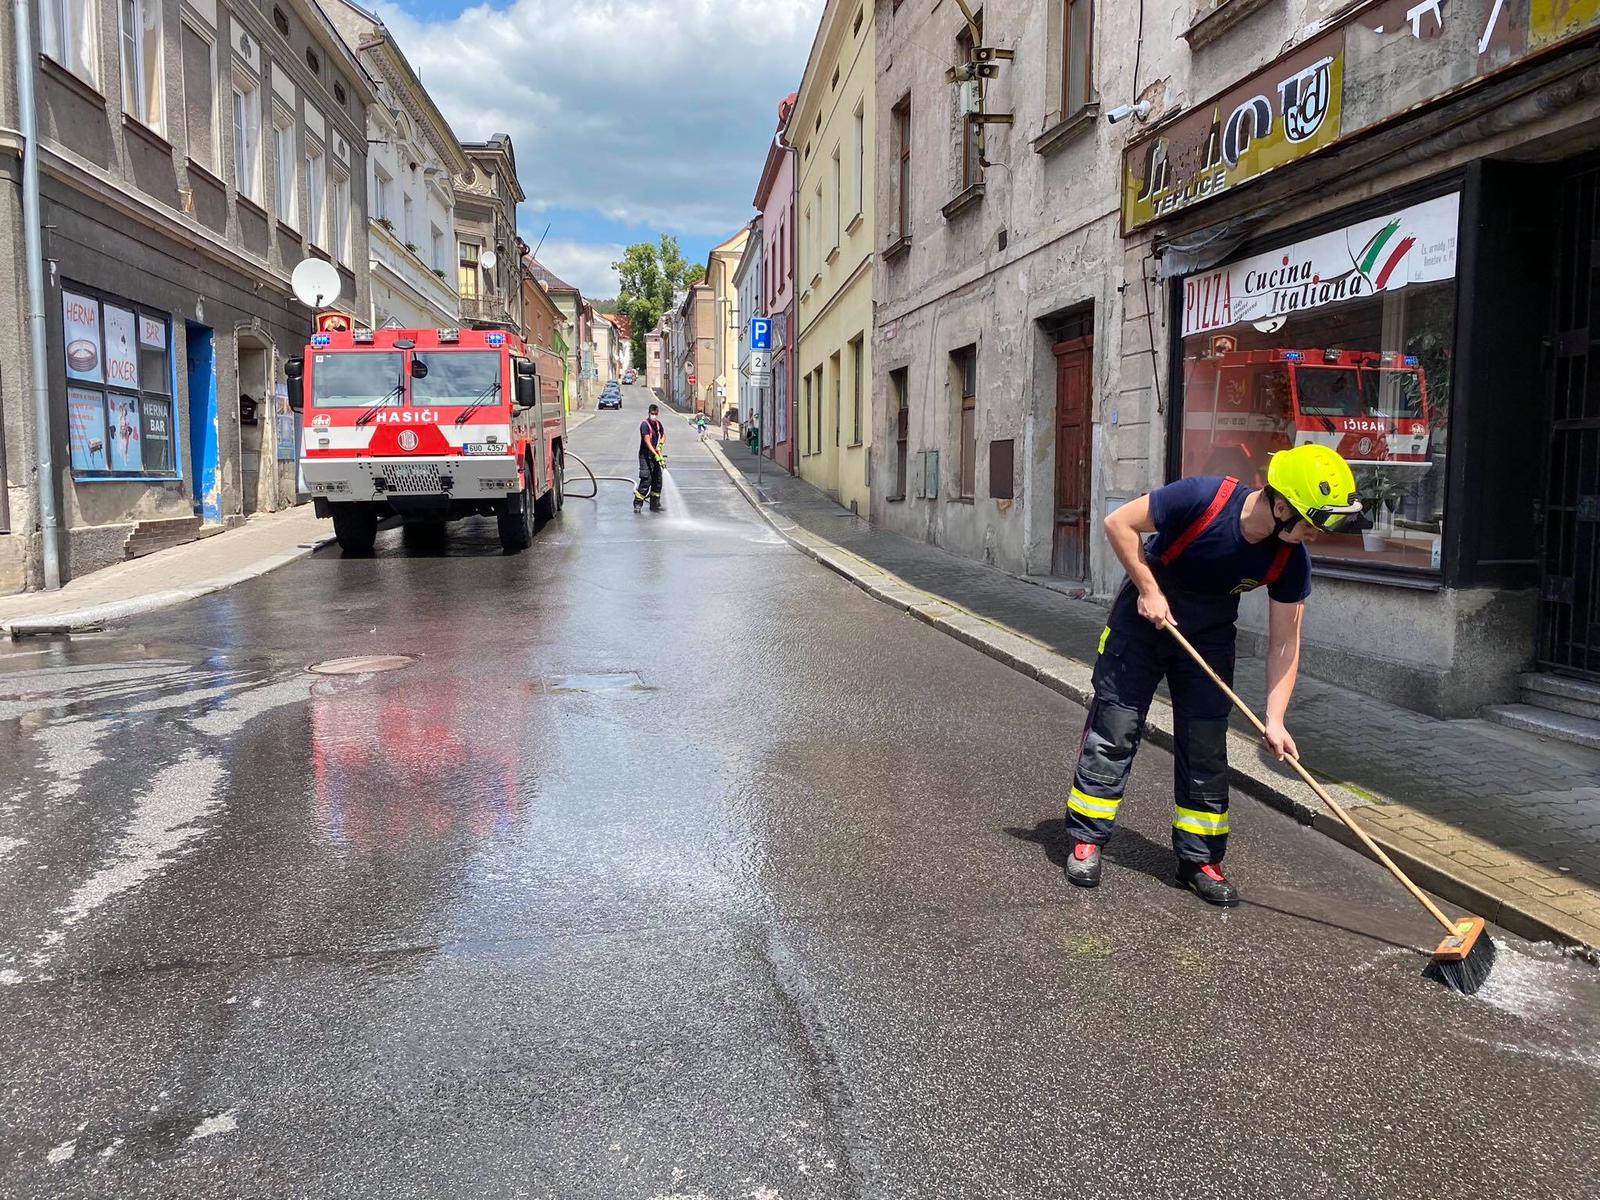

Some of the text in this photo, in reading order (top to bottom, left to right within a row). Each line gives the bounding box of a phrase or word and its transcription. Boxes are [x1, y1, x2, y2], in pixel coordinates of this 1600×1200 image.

[1245, 256, 1313, 294] Cucina
[1186, 270, 1232, 333] PIZZA
[1271, 273, 1362, 314] Italiana
[67, 301, 96, 326] HERNA
[146, 321, 160, 342] BAR
[755, 322, 767, 340] P
[755, 357, 761, 367] 2
[143, 402, 168, 418] HERNA
[376, 409, 438, 423] HASIČI
[150, 419, 165, 433] BAR
[487, 444, 504, 452] 4357
